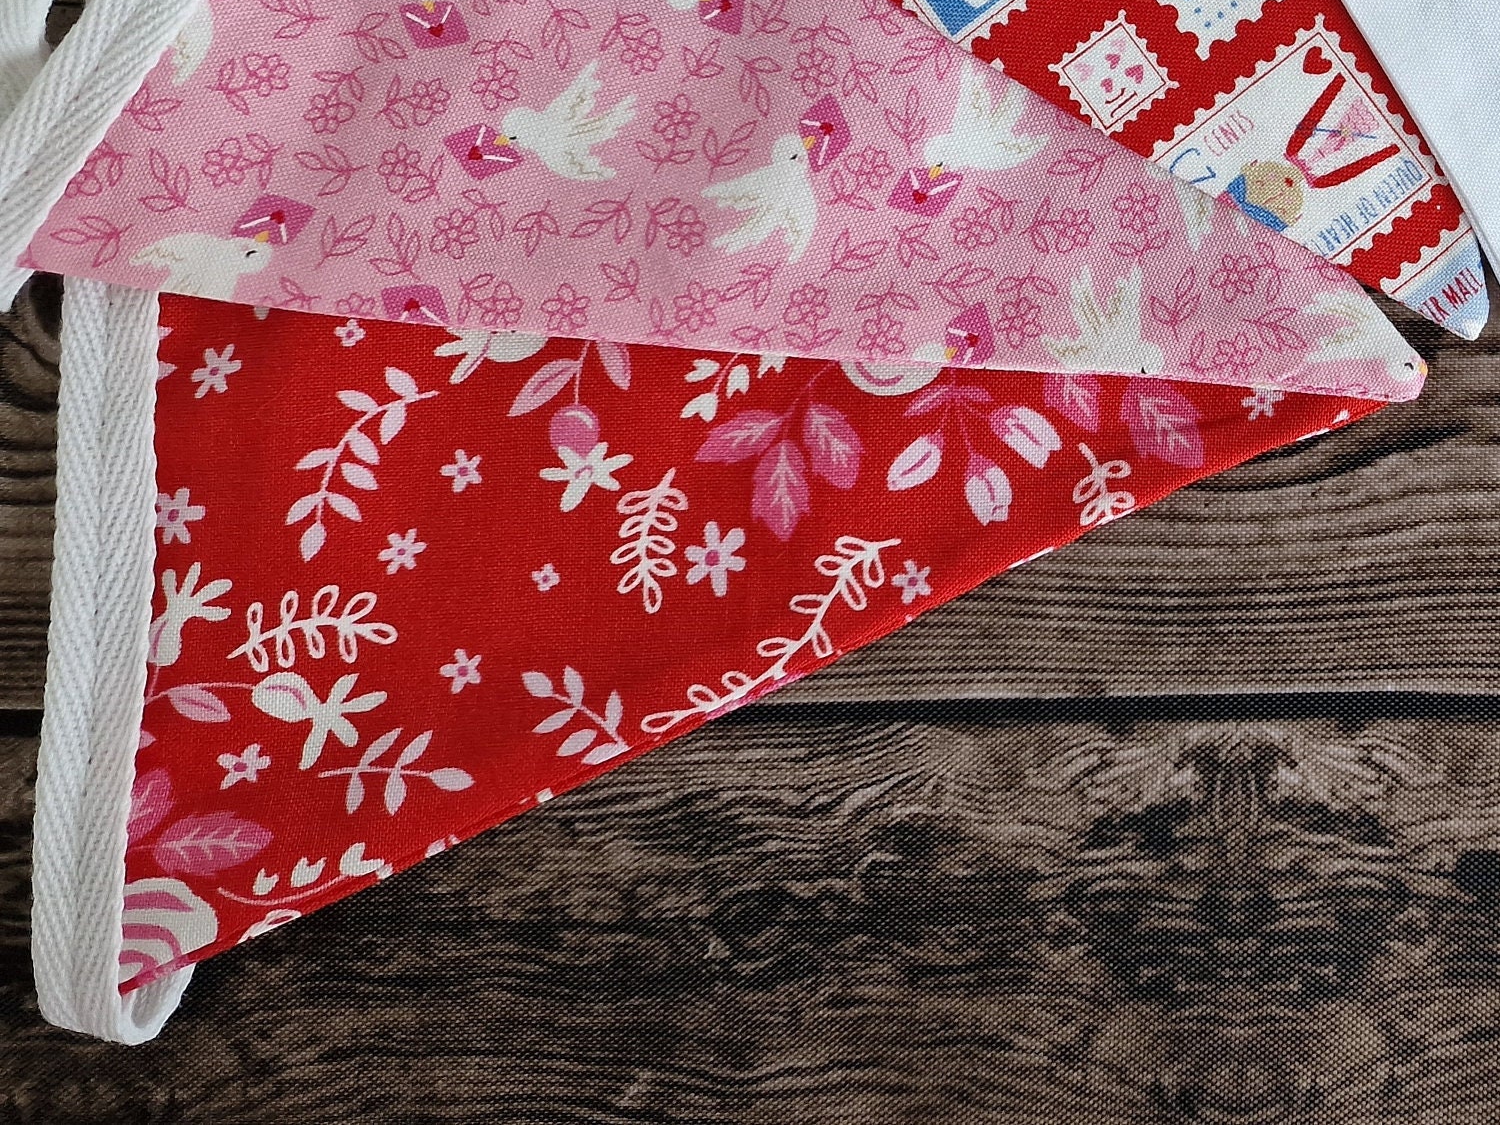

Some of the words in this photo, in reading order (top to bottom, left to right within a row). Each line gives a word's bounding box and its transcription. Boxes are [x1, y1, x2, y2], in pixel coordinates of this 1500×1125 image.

[1203, 109, 1255, 158] CENTS
[1372, 156, 1424, 210] QUEEN
[1303, 211, 1361, 257] HEART
[1355, 195, 1380, 225] OF
[1418, 296, 1451, 323] IR
[1441, 266, 1484, 312] MAIL
